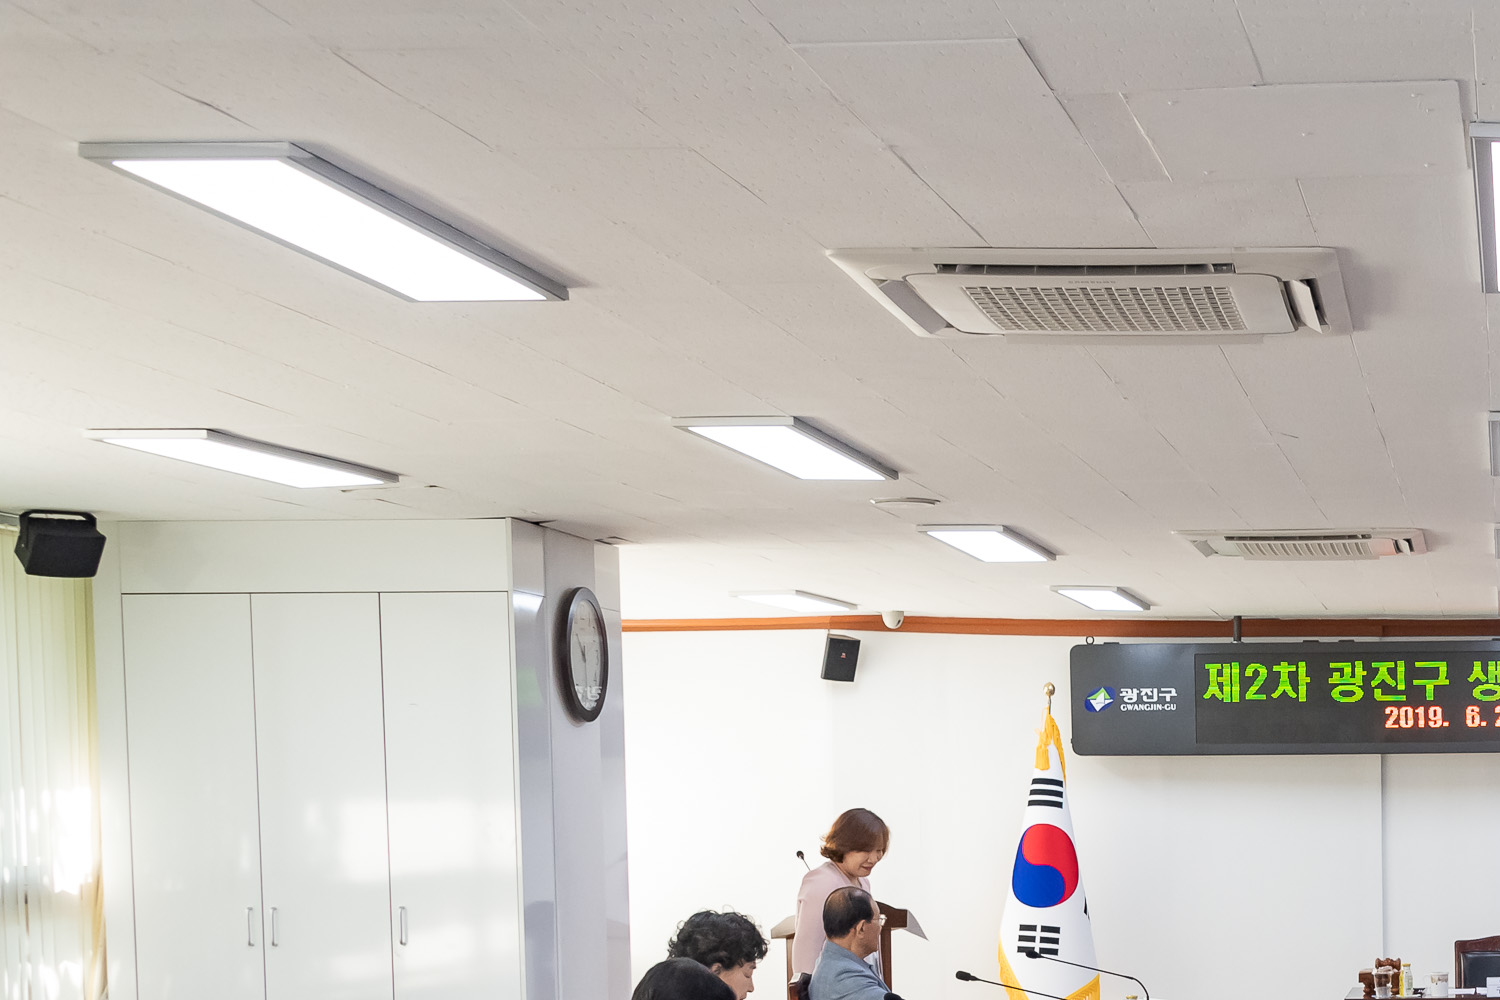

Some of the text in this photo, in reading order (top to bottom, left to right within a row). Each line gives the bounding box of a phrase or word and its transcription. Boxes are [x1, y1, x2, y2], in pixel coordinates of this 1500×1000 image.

[1203, 661, 1311, 703] 제2차
[1328, 660, 1450, 703] 광진구
[1119, 687, 1178, 703] 광진구
[1120, 703, 1177, 712] GWANGJIN-GU
[1384, 705, 1449, 729] 2019.
